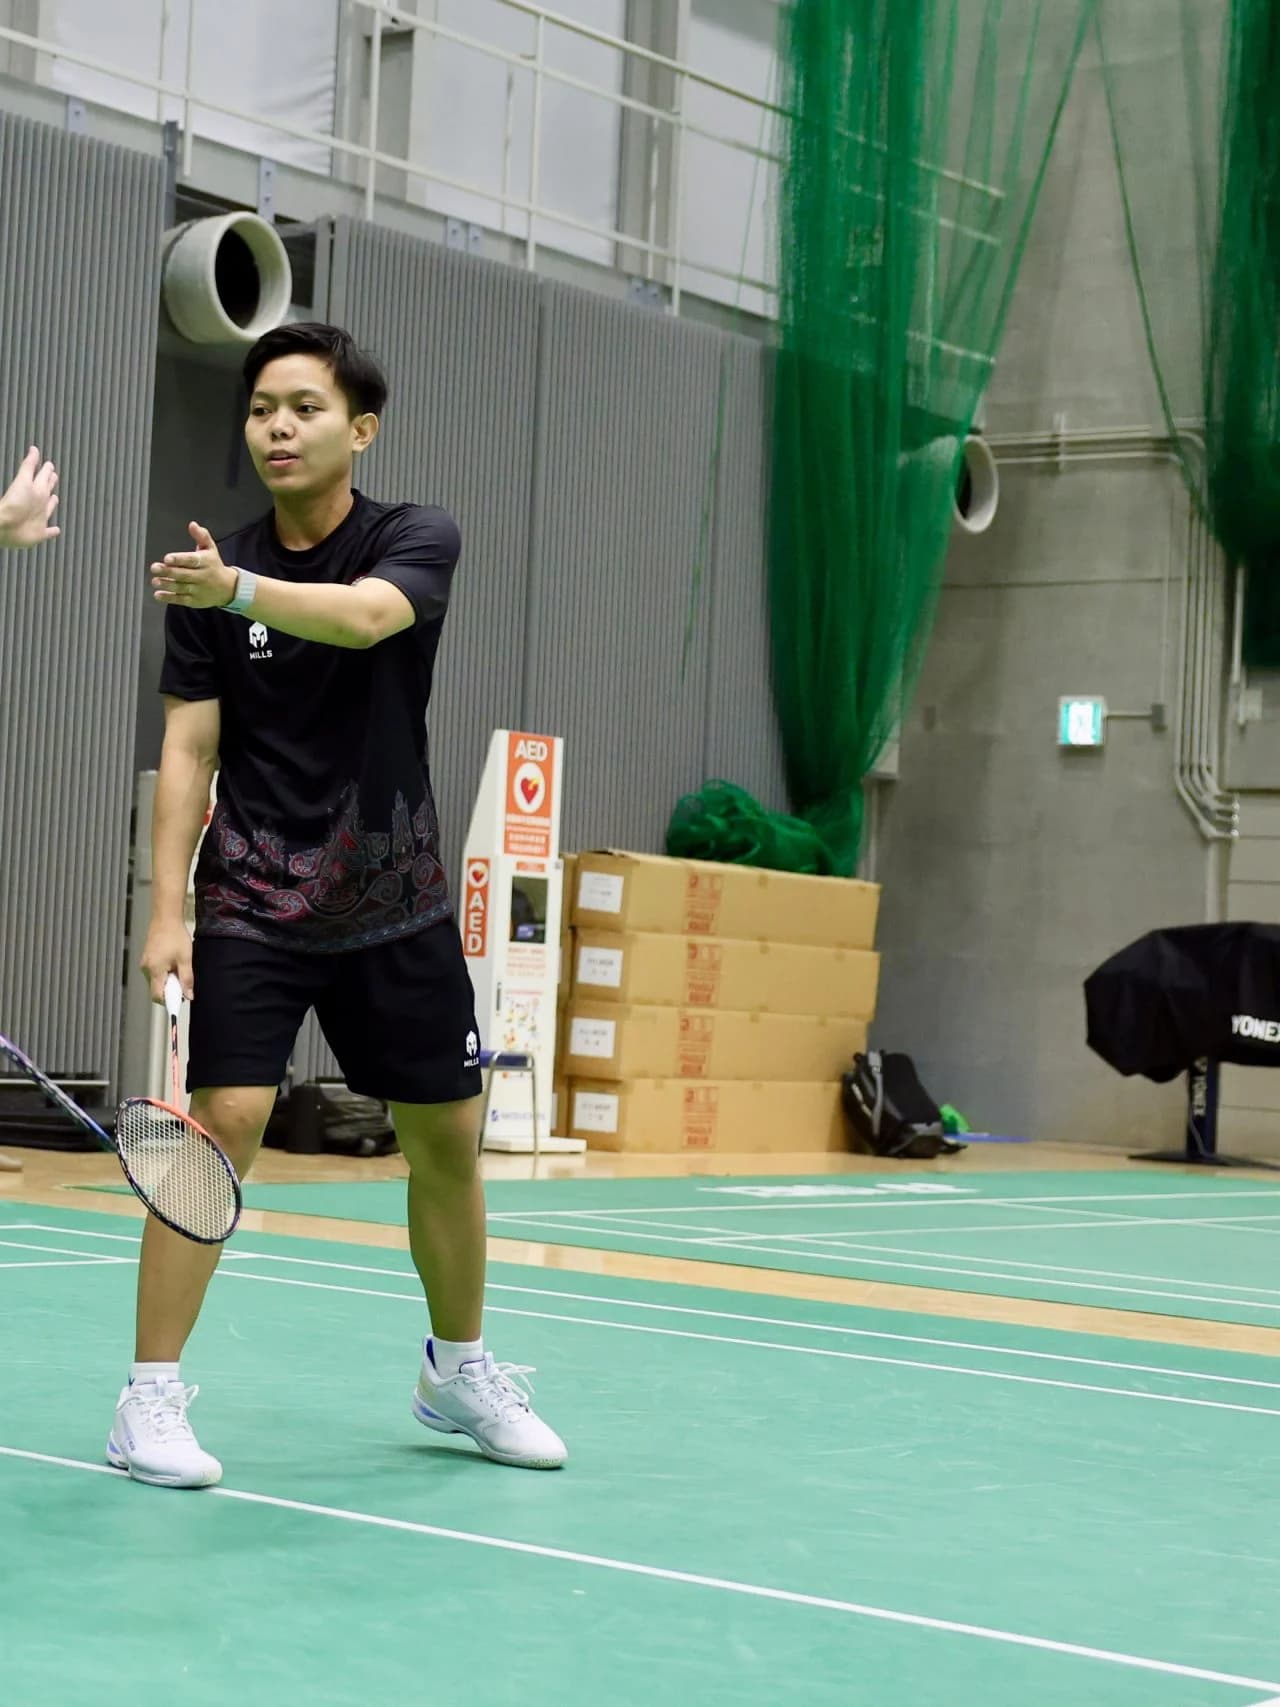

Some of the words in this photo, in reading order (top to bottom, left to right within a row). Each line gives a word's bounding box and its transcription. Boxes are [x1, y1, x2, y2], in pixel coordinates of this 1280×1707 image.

[249, 649, 273, 660] MILLS
[514, 739, 548, 762] AED
[467, 890, 485, 953] AED
[1231, 1014, 1280, 1042] YONE
